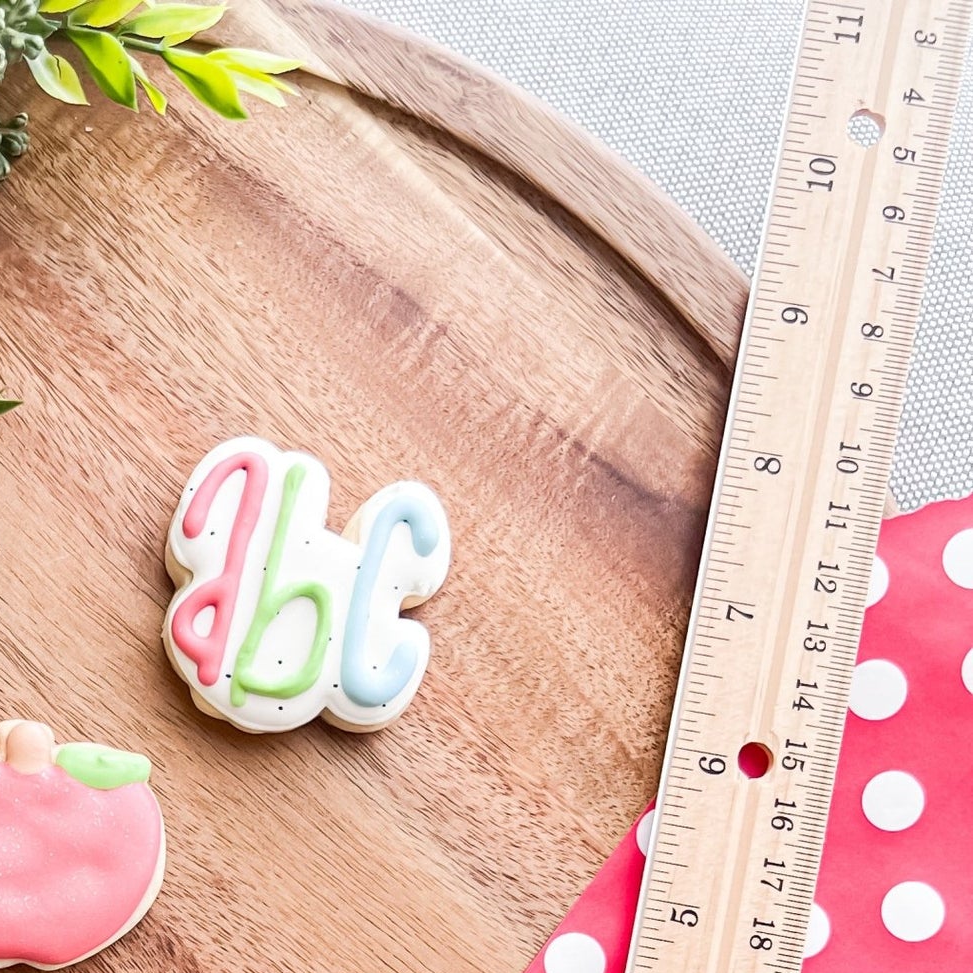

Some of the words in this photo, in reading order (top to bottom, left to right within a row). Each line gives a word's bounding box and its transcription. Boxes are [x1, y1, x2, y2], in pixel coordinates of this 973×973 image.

[833, 15, 864, 44] 11
[914, 29, 937, 45] 3
[902, 88, 926, 103] 4
[893, 146, 916, 162] 5
[806, 157, 837, 192] 10
[882, 205, 905, 221] 6
[872, 266, 895, 281] 7
[781, 306, 809, 325] 9
[861, 322, 884, 338] 8
[850, 382, 873, 398] 9
[754, 456, 781, 475] 8
[836, 441, 862, 474] 10
[825, 501, 851, 529] 11
[171, 452, 439, 708] abc
[814, 560, 840, 594] 12
[725, 604, 754, 622] 7
[803, 620, 829, 653] 13
[792, 679, 819, 711] 14
[698, 756, 726, 775] 6
[781, 738, 808, 773] 15
[770, 798, 797, 832] 16
[760, 857, 786, 892] 17
[670, 907, 699, 927] 5
[749, 917, 776, 951] 18
